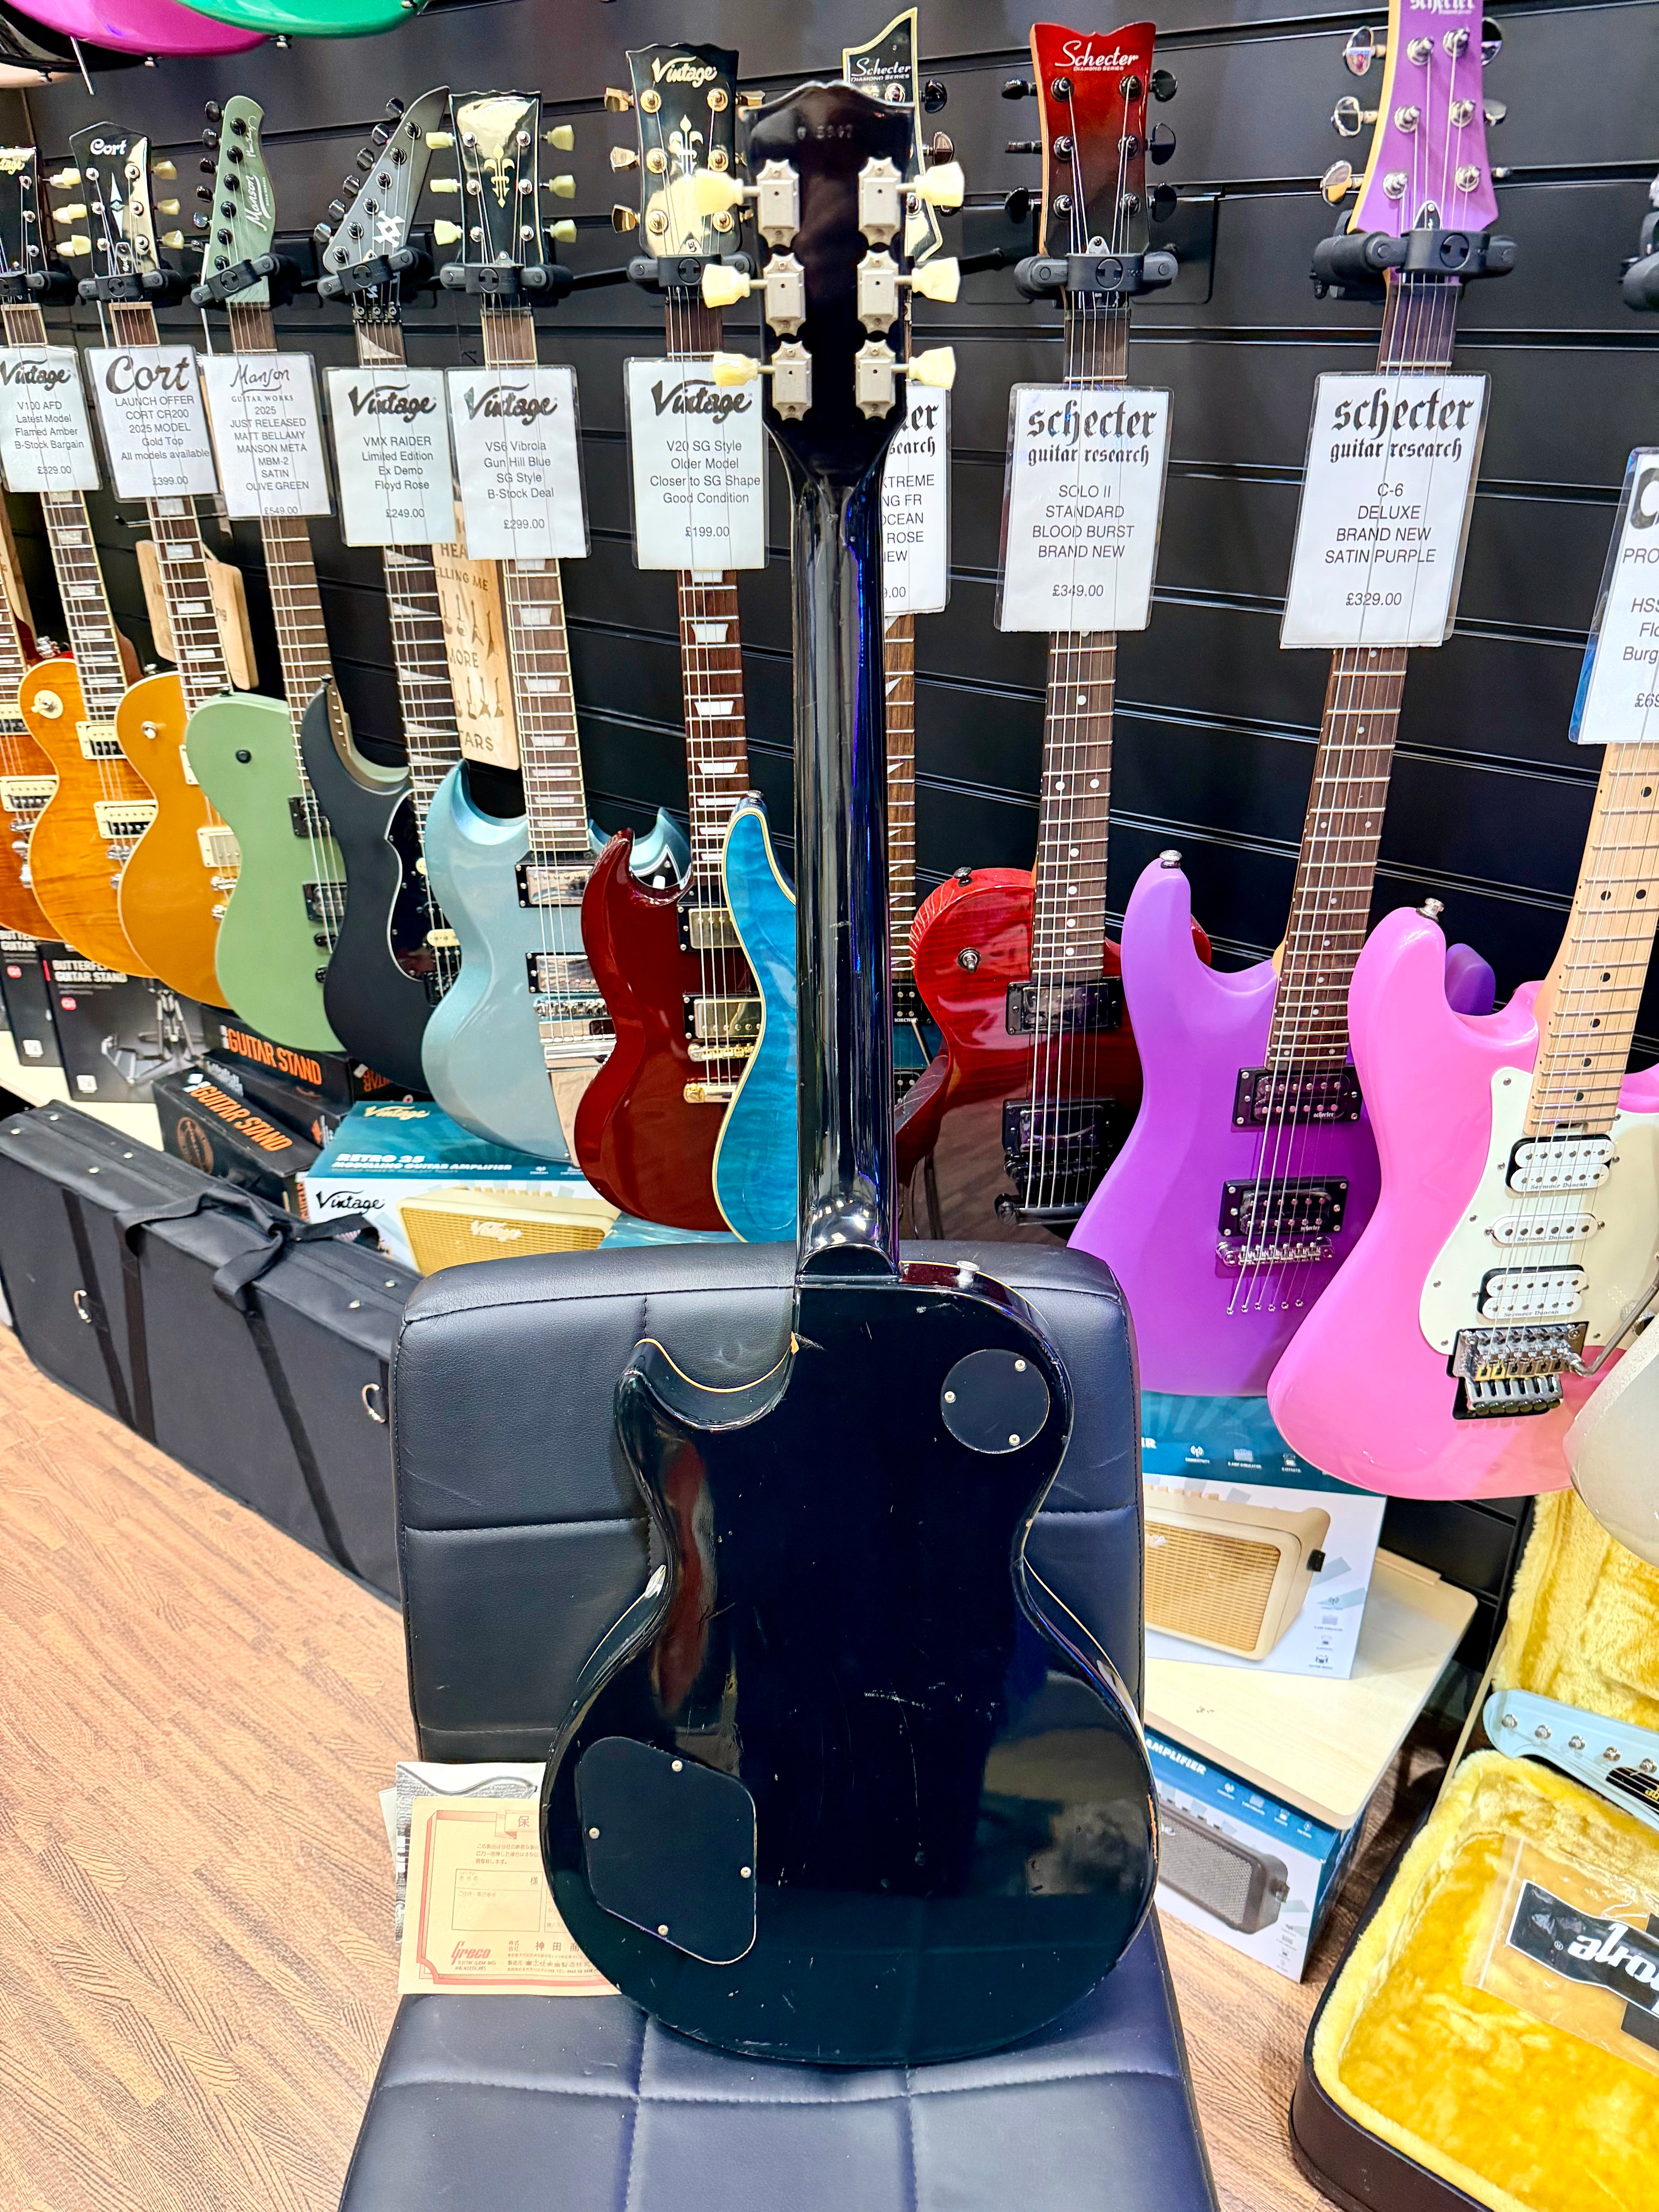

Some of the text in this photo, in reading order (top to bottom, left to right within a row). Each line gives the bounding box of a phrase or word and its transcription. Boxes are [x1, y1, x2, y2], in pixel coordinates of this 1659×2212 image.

[1054, 40, 1139, 67] Schecter
[651, 56, 718, 88] Vintage
[851, 58, 911, 76] Schecter
[90, 138, 127, 155] Cort
[244, 175, 267, 231] Manson
[0, 359, 71, 391] Vintage
[106, 356, 190, 394] Cort
[230, 364, 290, 387] Manson
[17, 401, 62, 410] V100 AFD
[115, 395, 194, 406] LAUNCH OFFER
[348, 384, 437, 423] Vintage
[464, 383, 558, 426] Vintage
[651, 380, 752, 424] Vintage
[126, 409, 189, 420] CORT CR200
[255, 406, 276, 414] 2025
[1331, 388, 1475, 440] schecter
[129, 423, 191, 433] 2025 MODEL
[230, 418, 306, 428] JUST RELEASED
[1027, 399, 1157, 446] schecter
[142, 437, 184, 447] Gold Top
[234, 431, 305, 440] MATT BELLAMY
[364, 436, 431, 446] VMX RAIDER
[15, 440, 84, 450] B-Stock Bargain
[237, 443, 307, 453] MANSON META
[485, 441, 546, 452] VS6 Vibrola
[667, 441, 742, 454] V20 SG Style
[890, 436, 935, 457] search
[1330, 438, 1462, 463] guitar research
[136, 452, 167, 460] models
[170, 449, 210, 458] available
[258, 457, 289, 465] MBM-2
[362, 451, 433, 461] Limited Edition
[1028, 445, 1149, 467] guitar research
[484, 457, 551, 468] Gun Hill Blue
[671, 458, 738, 469] Older Model
[38, 466, 71, 474] £329.00
[261, 469, 289, 478] SATIN
[379, 466, 423, 475] Ex Demo
[153, 476, 188, 485] £399.00
[497, 472, 542, 484] SG Style
[650, 475, 760, 488] Closer to SG Shape
[246, 481, 309, 491] OLIVE GREEN
[375, 480, 429, 491] Floyd Rose
[1059, 485, 1099, 498] SOLO
[1377, 483, 1403, 497] C-6
[488, 488, 554, 499] B-Stock Deal
[663, 493, 749, 503] Good Condition
[905, 494, 921, 506] FR
[264, 506, 298, 515] £549.00
[386, 508, 424, 518] £249.00
[1046, 505, 1124, 518] STANDARD
[1358, 505, 1421, 519] DELUXE
[504, 519, 544, 529] £299.00
[883, 512, 923, 525] CEAN
[685, 526, 730, 538] £199.00
[887, 531, 924, 544] ROSE
[1032, 525, 1135, 538] BLOOD BURST
[1336, 527, 1431, 542] BRAND NEW
[884, 550, 907, 562] EW
[1038, 545, 1125, 558] BRAND NEW
[1325, 549, 1436, 564] SATIN PURPLE
[473, 575, 488, 591] ME
[1052, 584, 1103, 597] £349.00
[1346, 592, 1402, 606] £329.00
[0, 941, 36, 951] GUITAR
[54, 971, 128, 982] GUITAR STAND
[227, 1028, 276, 1068] GUITAR
[276, 1047, 322, 1085] STAND
[190, 1085, 293, 1152] GUITAR STAND
[364, 1106, 430, 1121] Vintage
[337, 1153, 397, 1162] RETRO
[316, 1190, 385, 1215] Vintage
[1146, 1738, 1206, 1775] AMPLIFIER
[518, 1815, 529, 1828] 保
[451, 1941, 491, 1965] Greco
